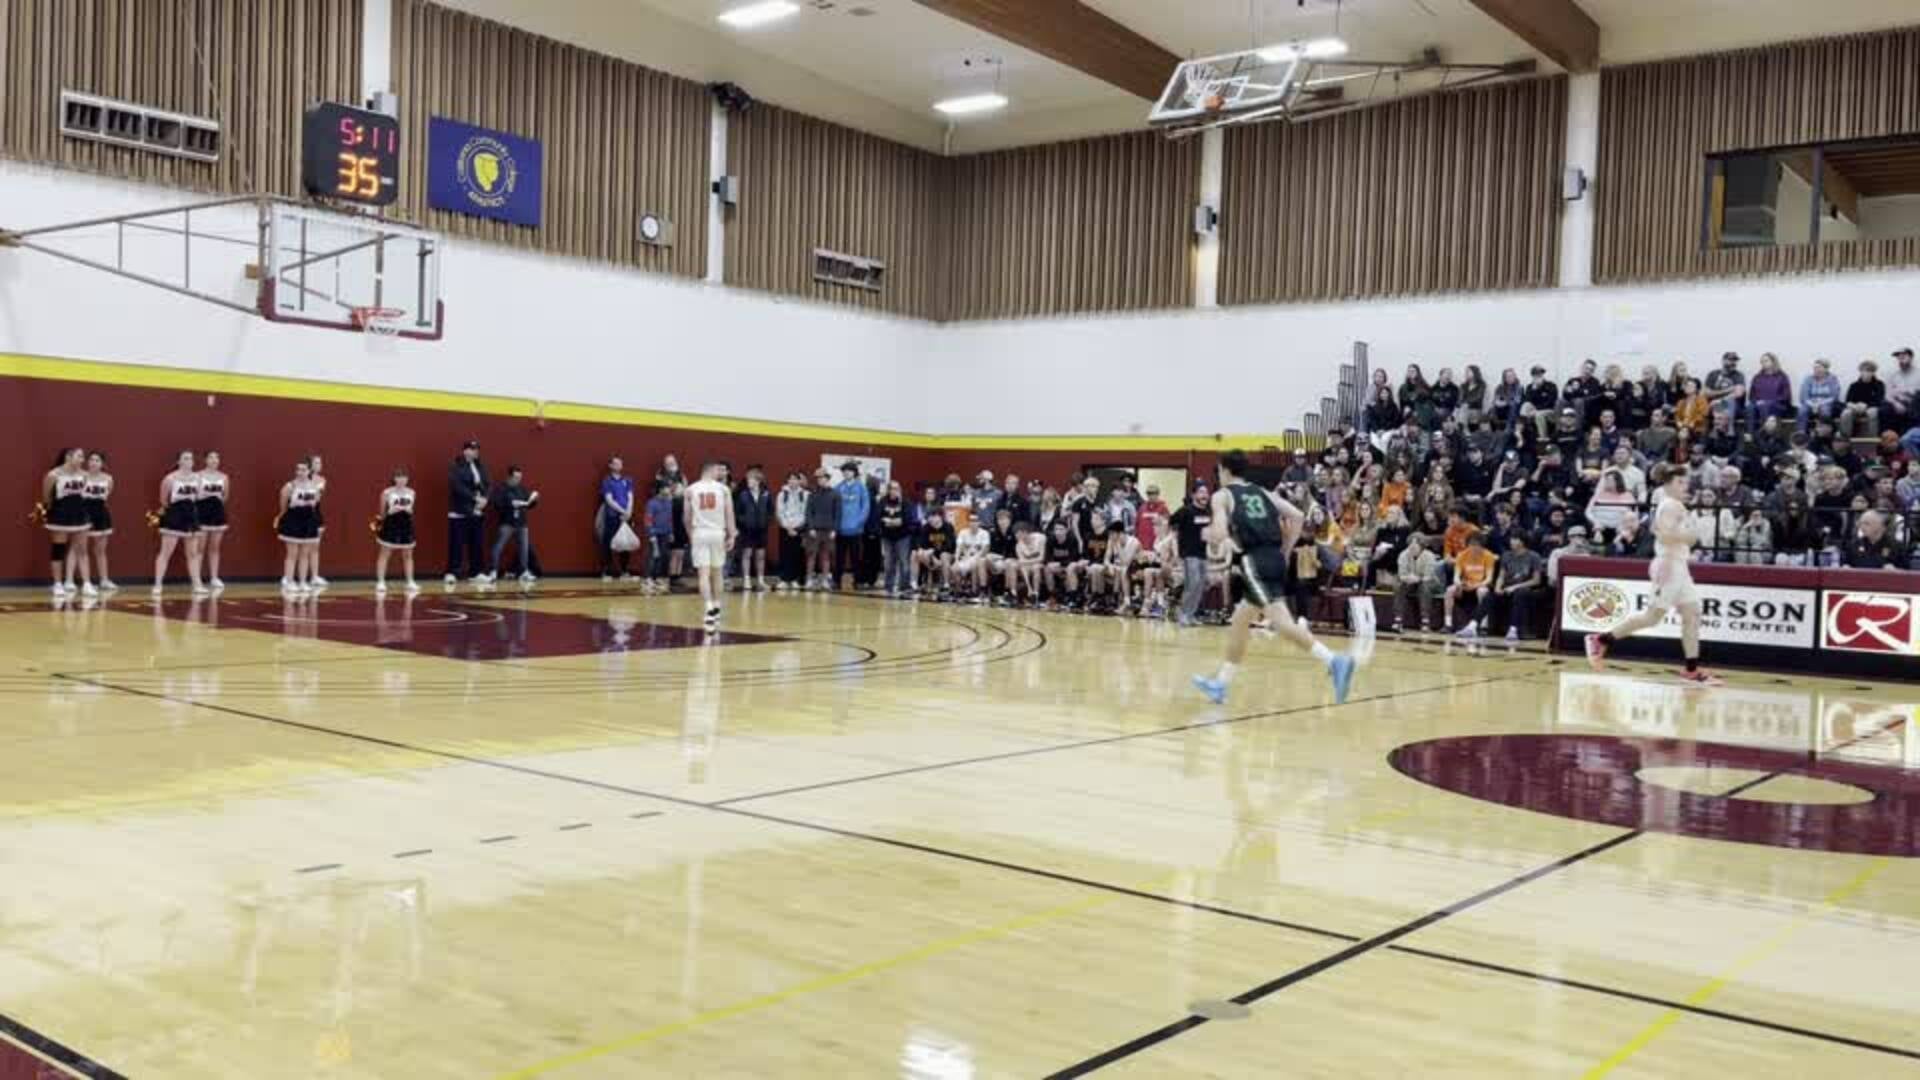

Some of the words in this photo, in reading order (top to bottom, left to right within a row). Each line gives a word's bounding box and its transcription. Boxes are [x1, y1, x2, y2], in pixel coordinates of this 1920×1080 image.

[339, 118, 395, 153] 5:11
[338, 153, 379, 197] 35
[1241, 494, 1267, 518] 33
[1635, 592, 1807, 623] PRSON
[1729, 621, 1797, 634] CENTER
